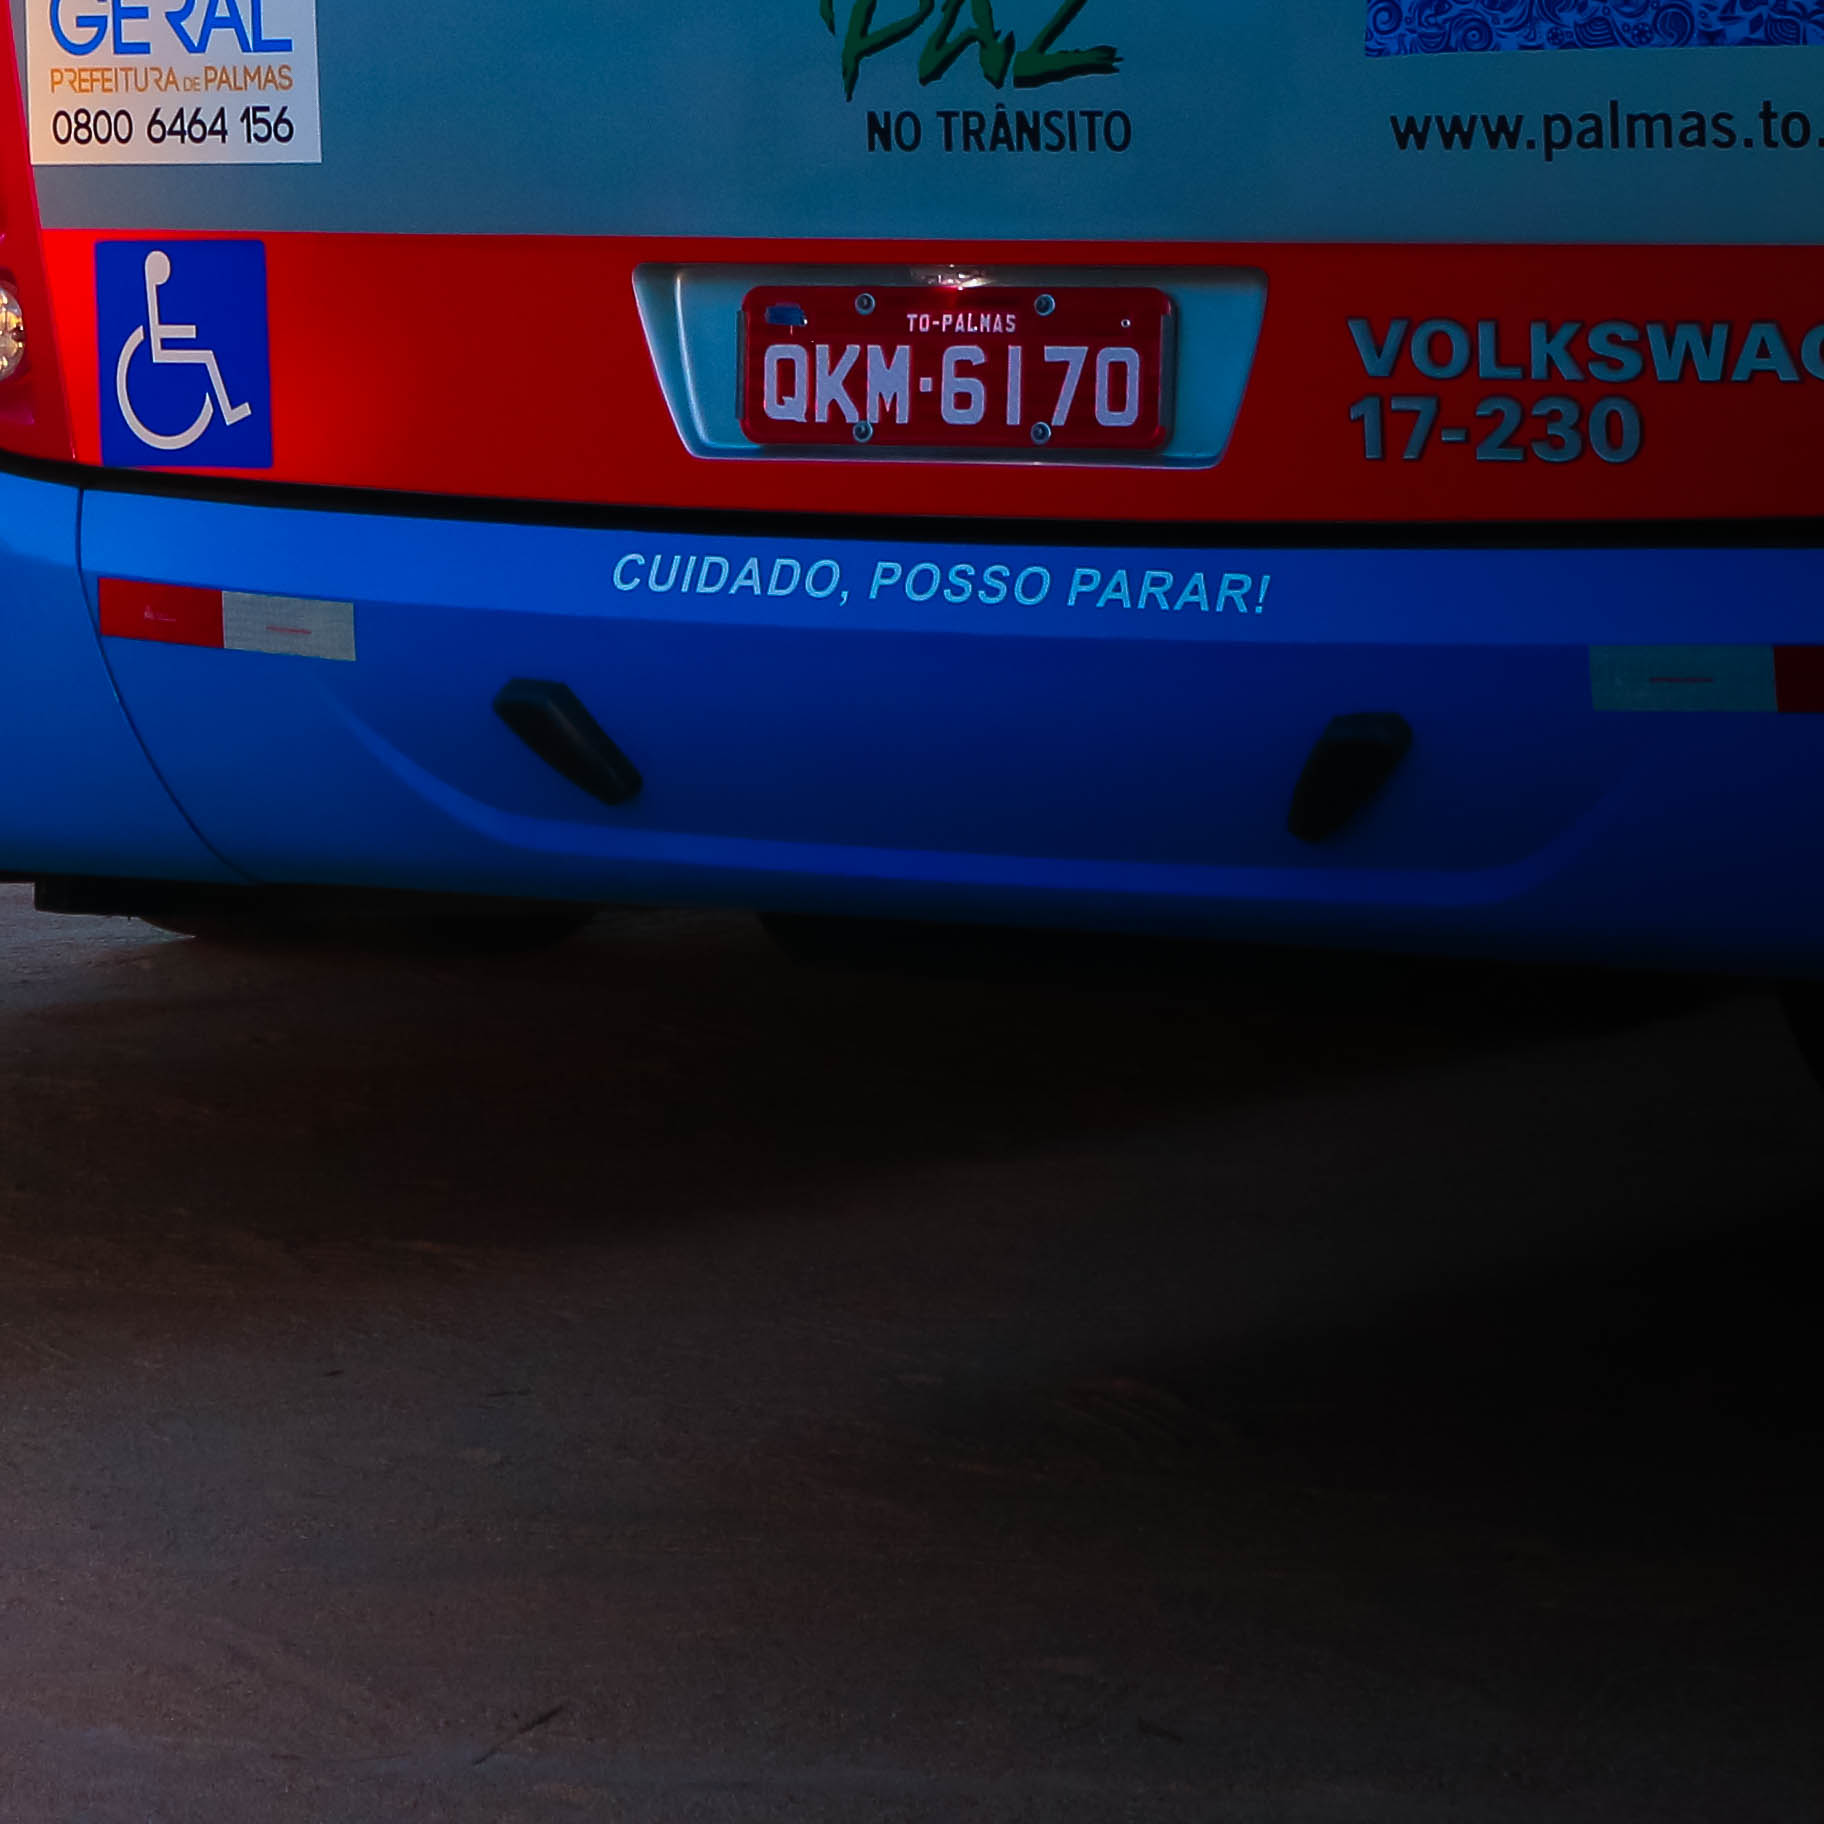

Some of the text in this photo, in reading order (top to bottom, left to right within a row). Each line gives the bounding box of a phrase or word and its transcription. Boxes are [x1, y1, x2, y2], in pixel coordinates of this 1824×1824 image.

[50, 64, 179, 94] PREFEITURA
[203, 64, 294, 93] PALMAS
[52, 106, 295, 145] 0800 6464 156
[866, 102, 1132, 153] NO TRÂNSITO
[906, 313, 1017, 333] TO-PALMAS
[1348, 394, 1643, 464] 17-230
[611, 552, 1272, 615] CUIDADO, POSSO PARAR!
